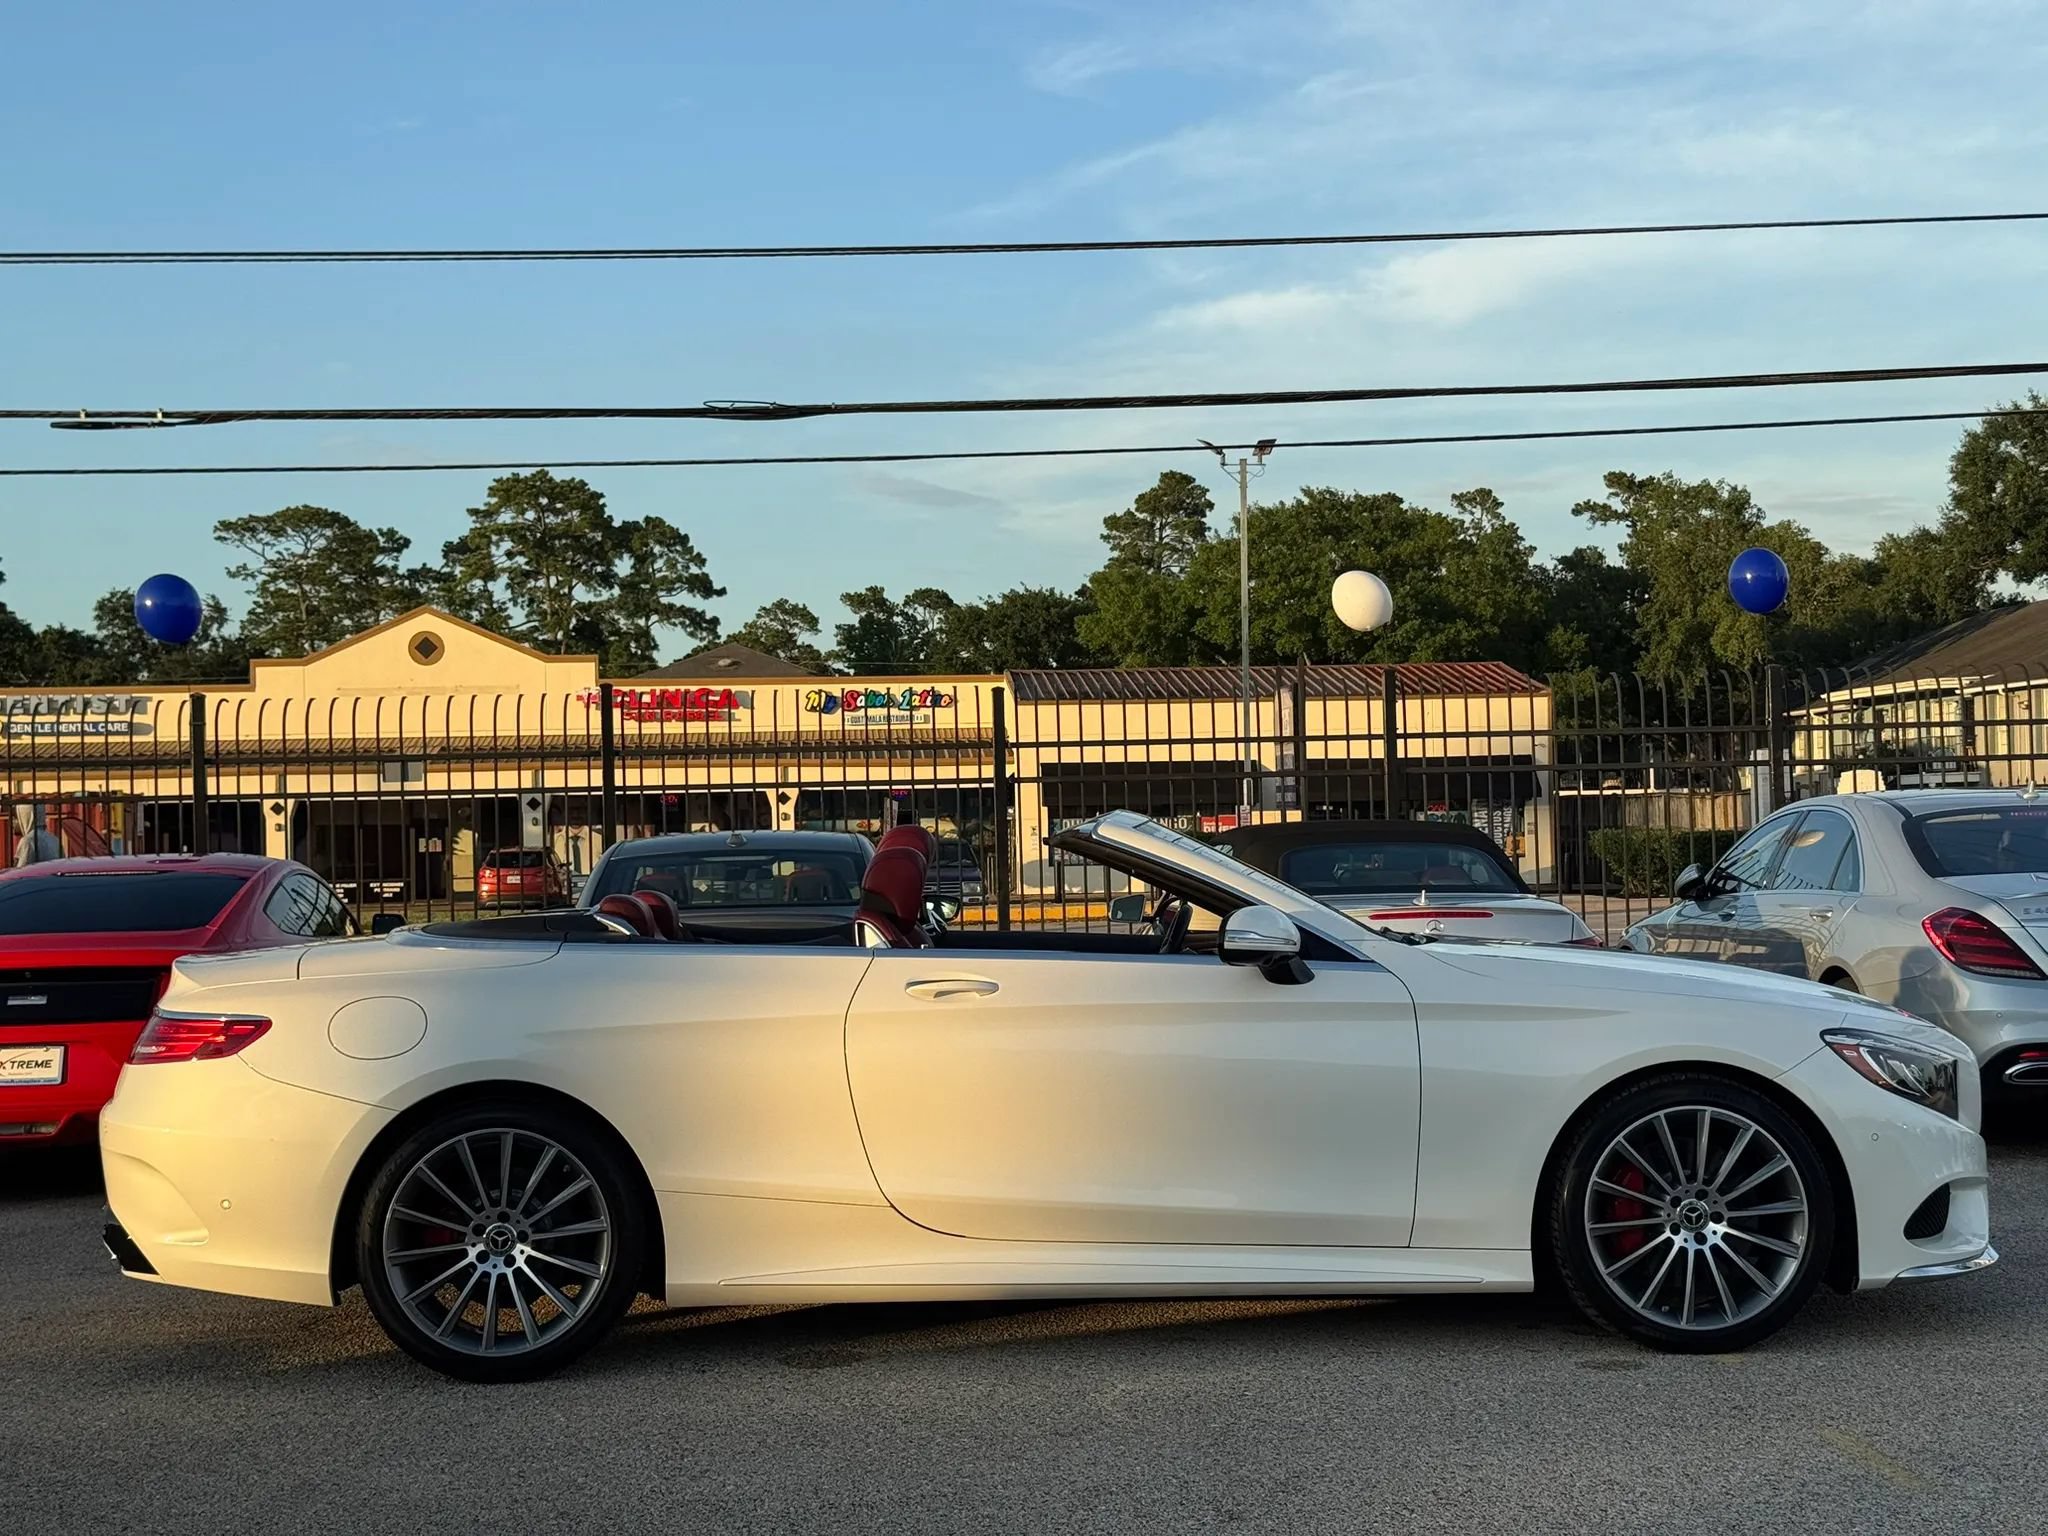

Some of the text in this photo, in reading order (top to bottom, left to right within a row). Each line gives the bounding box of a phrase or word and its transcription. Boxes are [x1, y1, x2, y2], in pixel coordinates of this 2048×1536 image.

[0, 695, 132, 714] ENTIST
[10, 722, 129, 733] GENTLE DENTAL CARE
